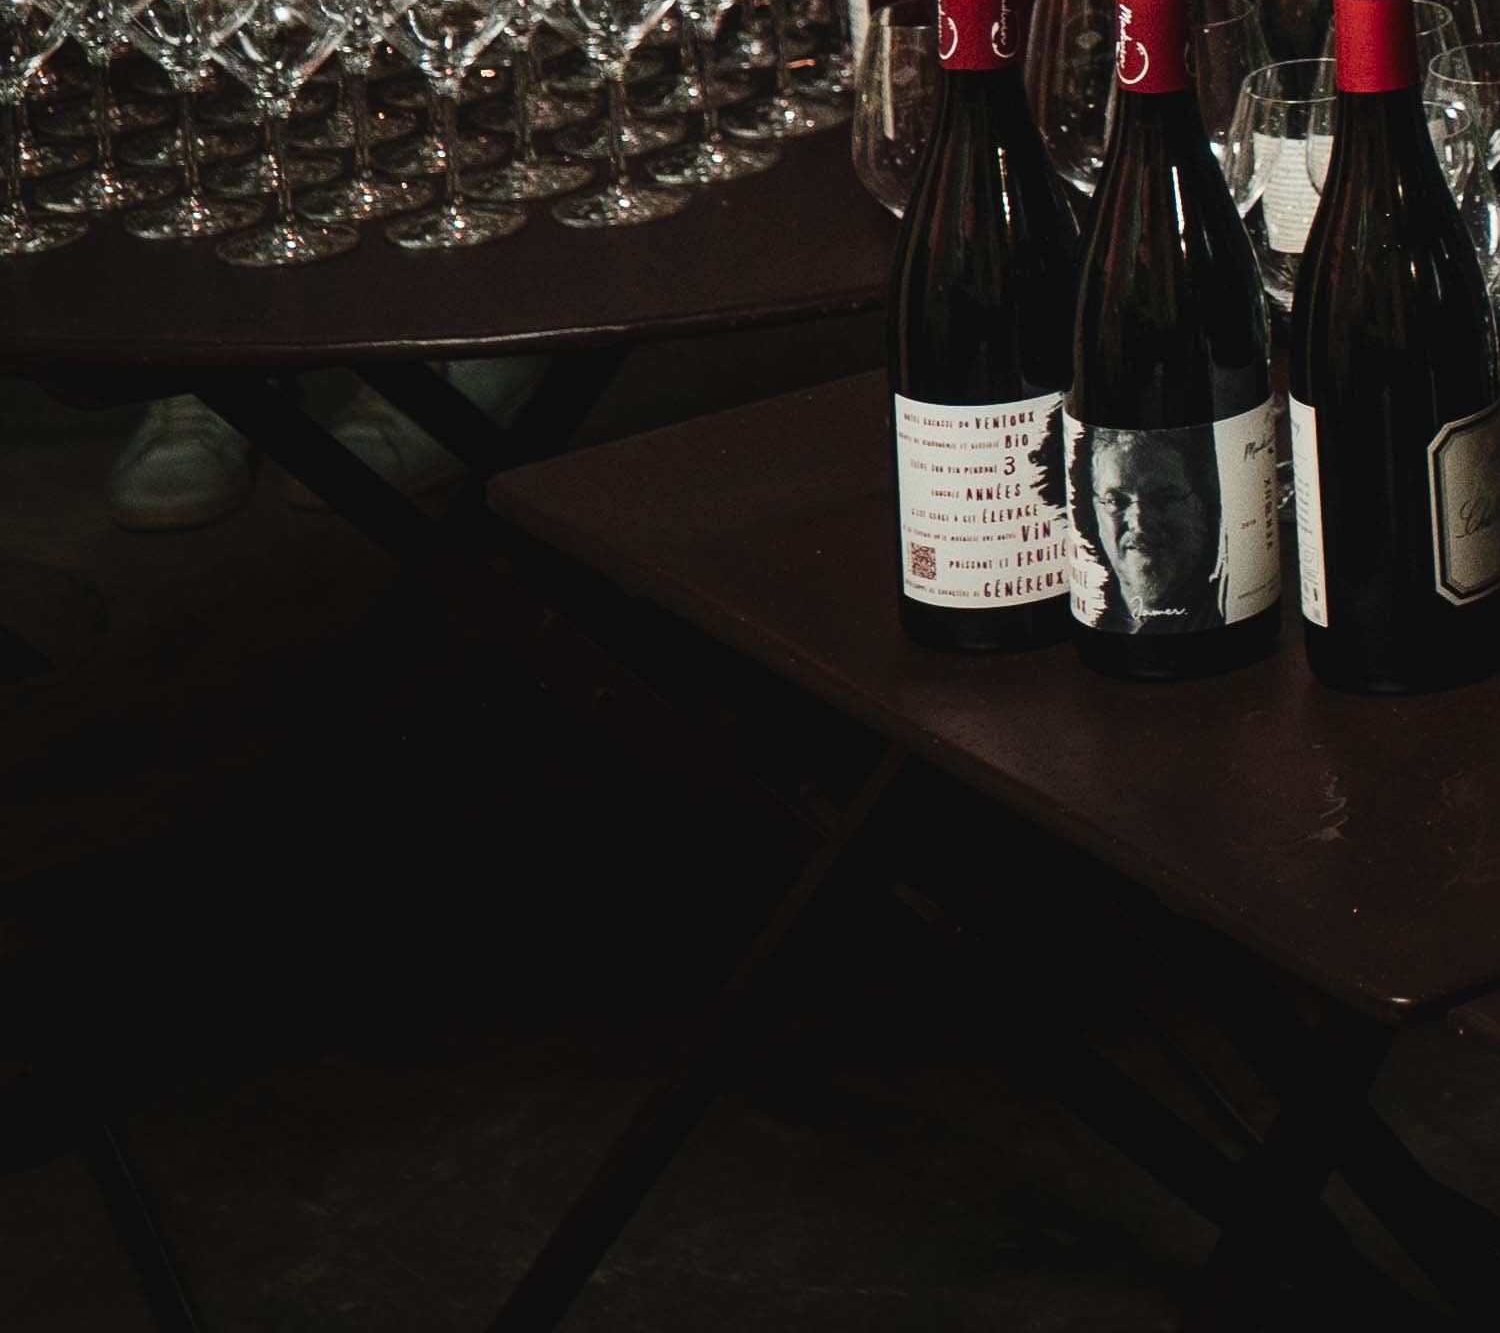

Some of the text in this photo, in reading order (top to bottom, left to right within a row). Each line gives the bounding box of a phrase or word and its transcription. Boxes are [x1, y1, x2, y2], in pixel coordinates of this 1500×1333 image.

[975, 410, 1035, 430] VENTOUX
[1003, 456, 1016, 475] 3
[965, 483, 1022, 501] ANNÉES
[981, 503, 1039, 524] ÉLEVAGE
[983, 570, 1064, 599] GÉNÉREUX
